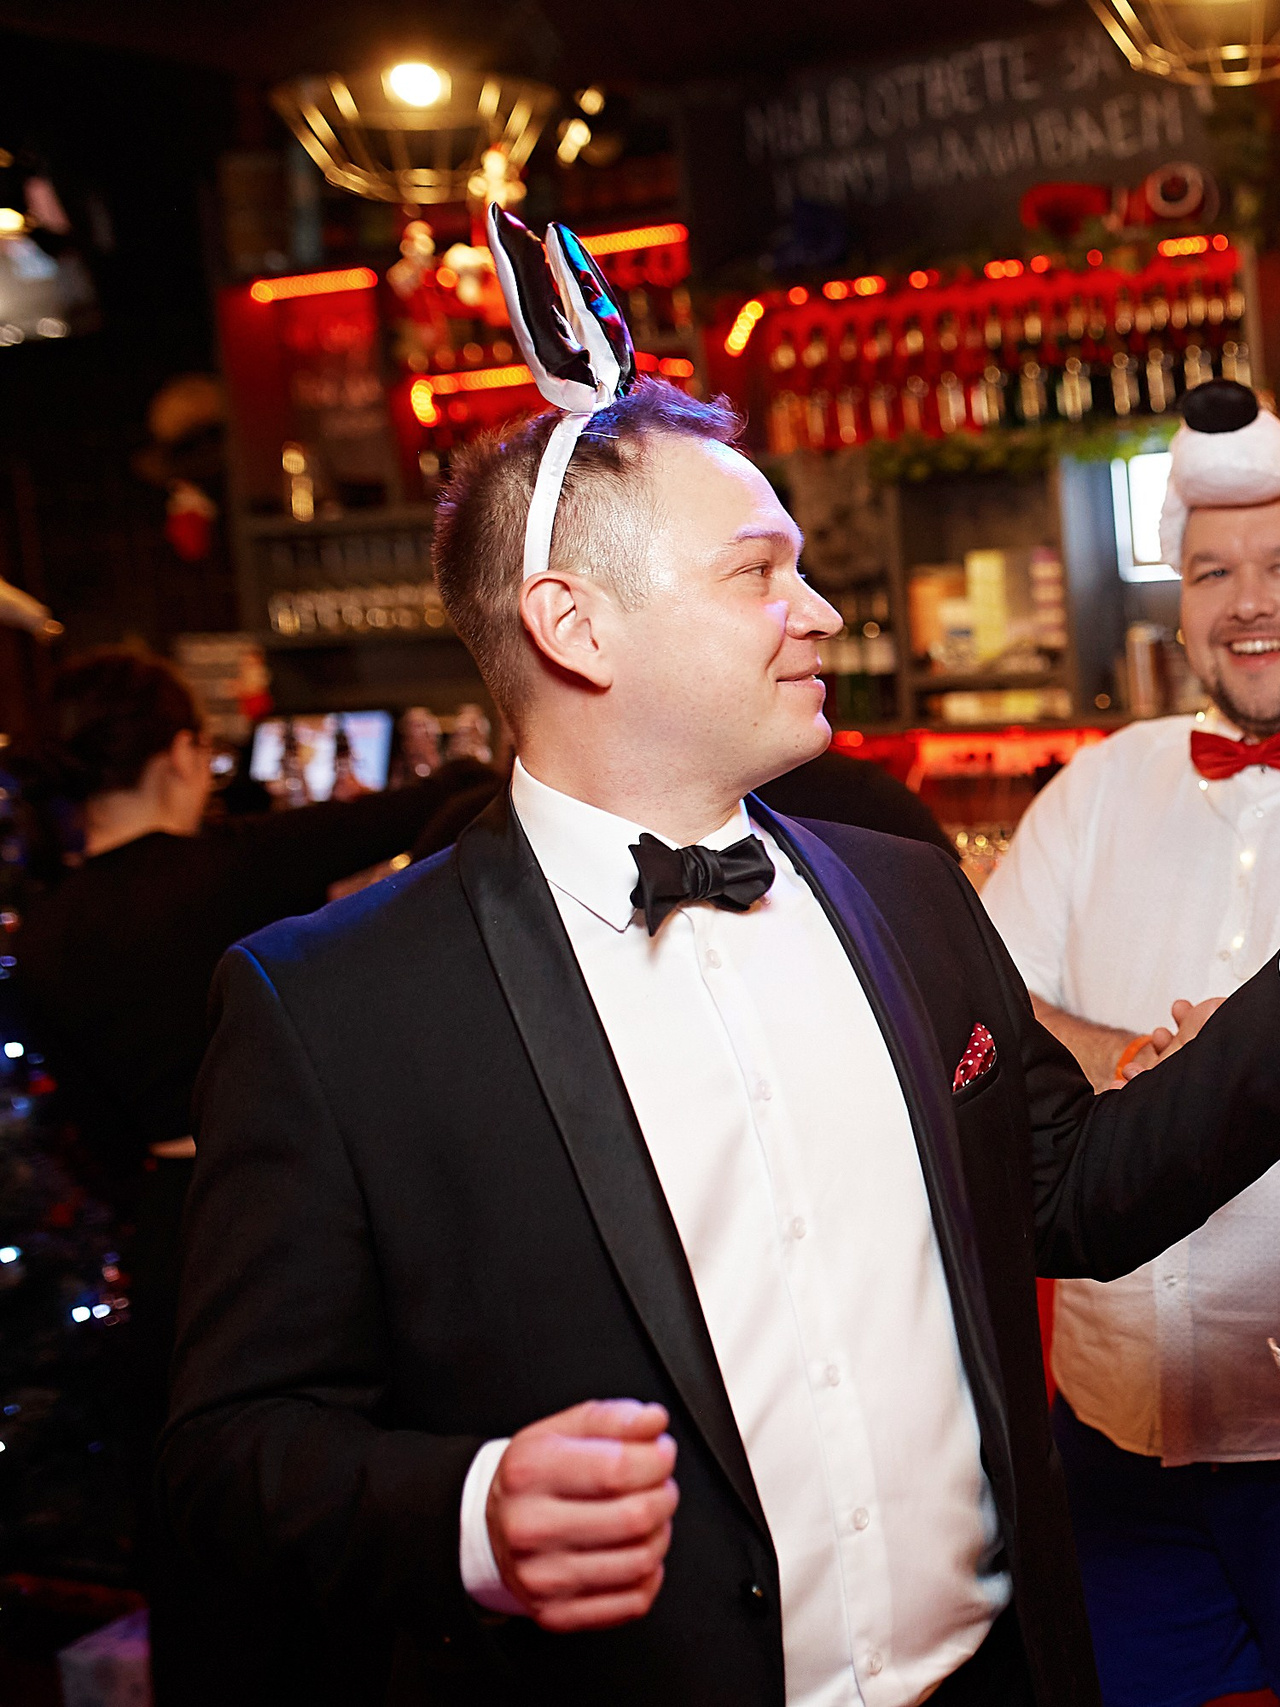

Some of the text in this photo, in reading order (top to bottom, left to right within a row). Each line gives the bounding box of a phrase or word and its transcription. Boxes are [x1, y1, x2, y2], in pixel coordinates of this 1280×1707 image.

[826, 78, 868, 147] В
[867, 39, 1042, 139] ОТВЕТЕ
[906, 89, 1185, 190] НАЛИВАЕМ
